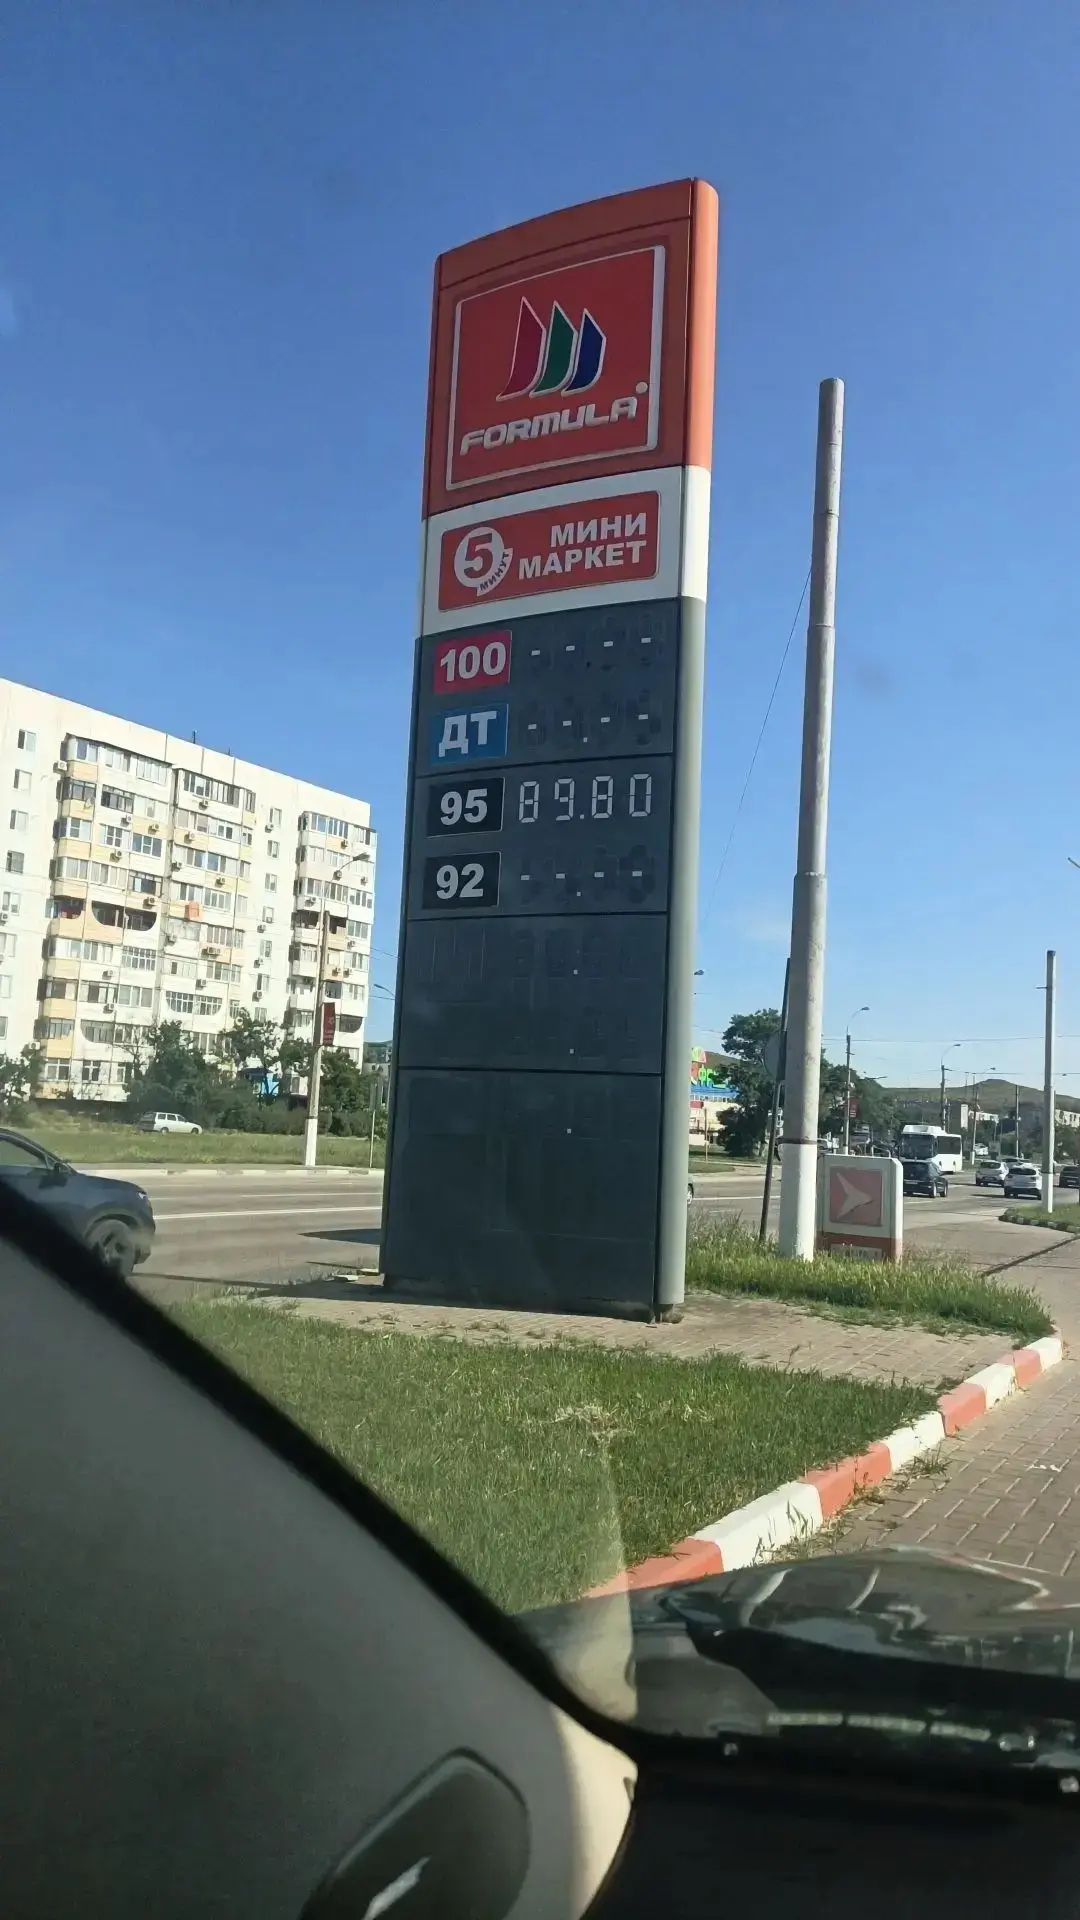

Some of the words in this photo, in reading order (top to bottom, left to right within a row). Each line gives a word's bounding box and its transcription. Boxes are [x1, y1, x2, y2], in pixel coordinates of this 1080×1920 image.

[459, 396, 638, 456] FORMULA
[550, 513, 646, 548] МИНИ
[463, 533, 493, 579] 5
[480, 552, 509, 591] МИНУТ
[518, 541, 647, 580] МАРКЕТ
[440, 641, 507, 683] 100
[438, 710, 497, 757] ДТ
[440, 788, 488, 826] 95
[518, 773, 652, 823] 89.80
[436, 863, 485, 900] 92
